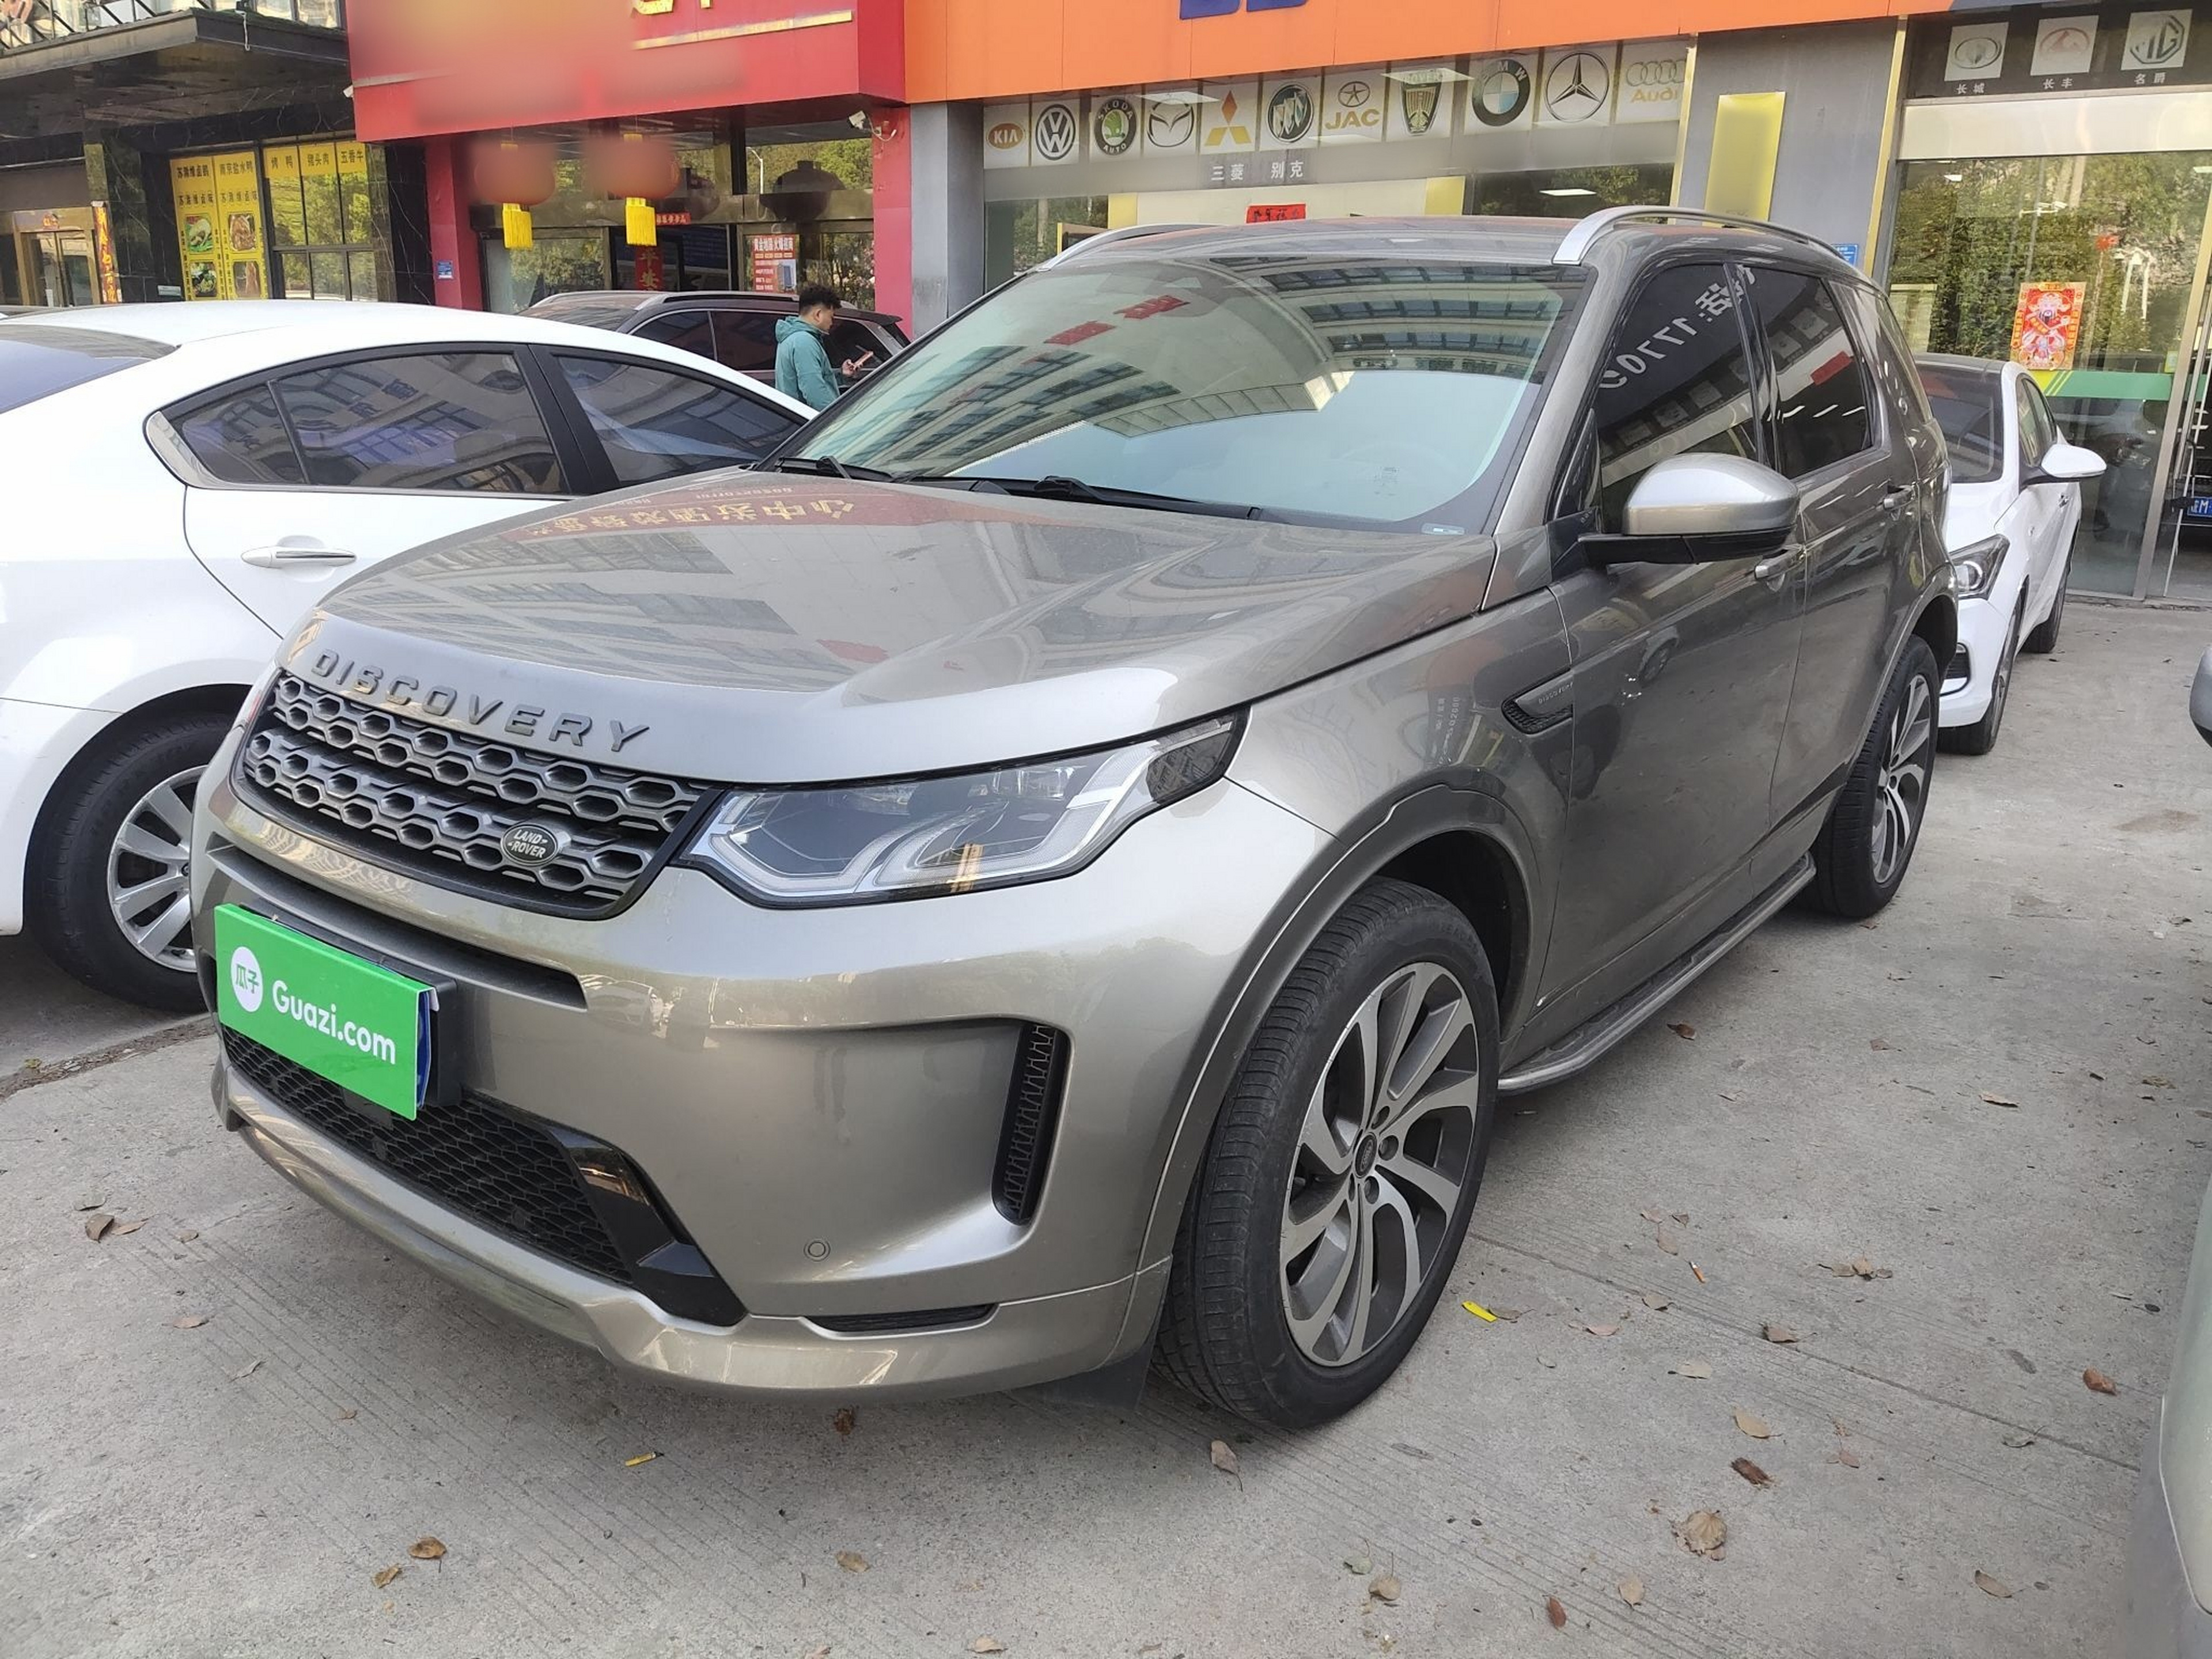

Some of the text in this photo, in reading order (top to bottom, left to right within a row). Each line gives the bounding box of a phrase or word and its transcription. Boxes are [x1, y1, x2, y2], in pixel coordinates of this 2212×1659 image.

[2043, 78, 2073, 89] 长丰
[2134, 73, 2166, 85] 名爵
[1631, 88, 1677, 103] Audi
[1956, 83, 1985, 94] 长城
[1325, 108, 1380, 130] JAC
[1103, 143, 1127, 154] AUTO
[1210, 163, 1245, 181] 三菱
[1270, 160, 1304, 179] 别克
[639, 248, 660, 291] 平安
[311, 648, 650, 752] DISCOVERY
[514, 829, 543, 844] LAND
[512, 840, 547, 858] ROVER
[235, 963, 259, 994] 瓜子
[272, 980, 396, 1065] Guazi.com
